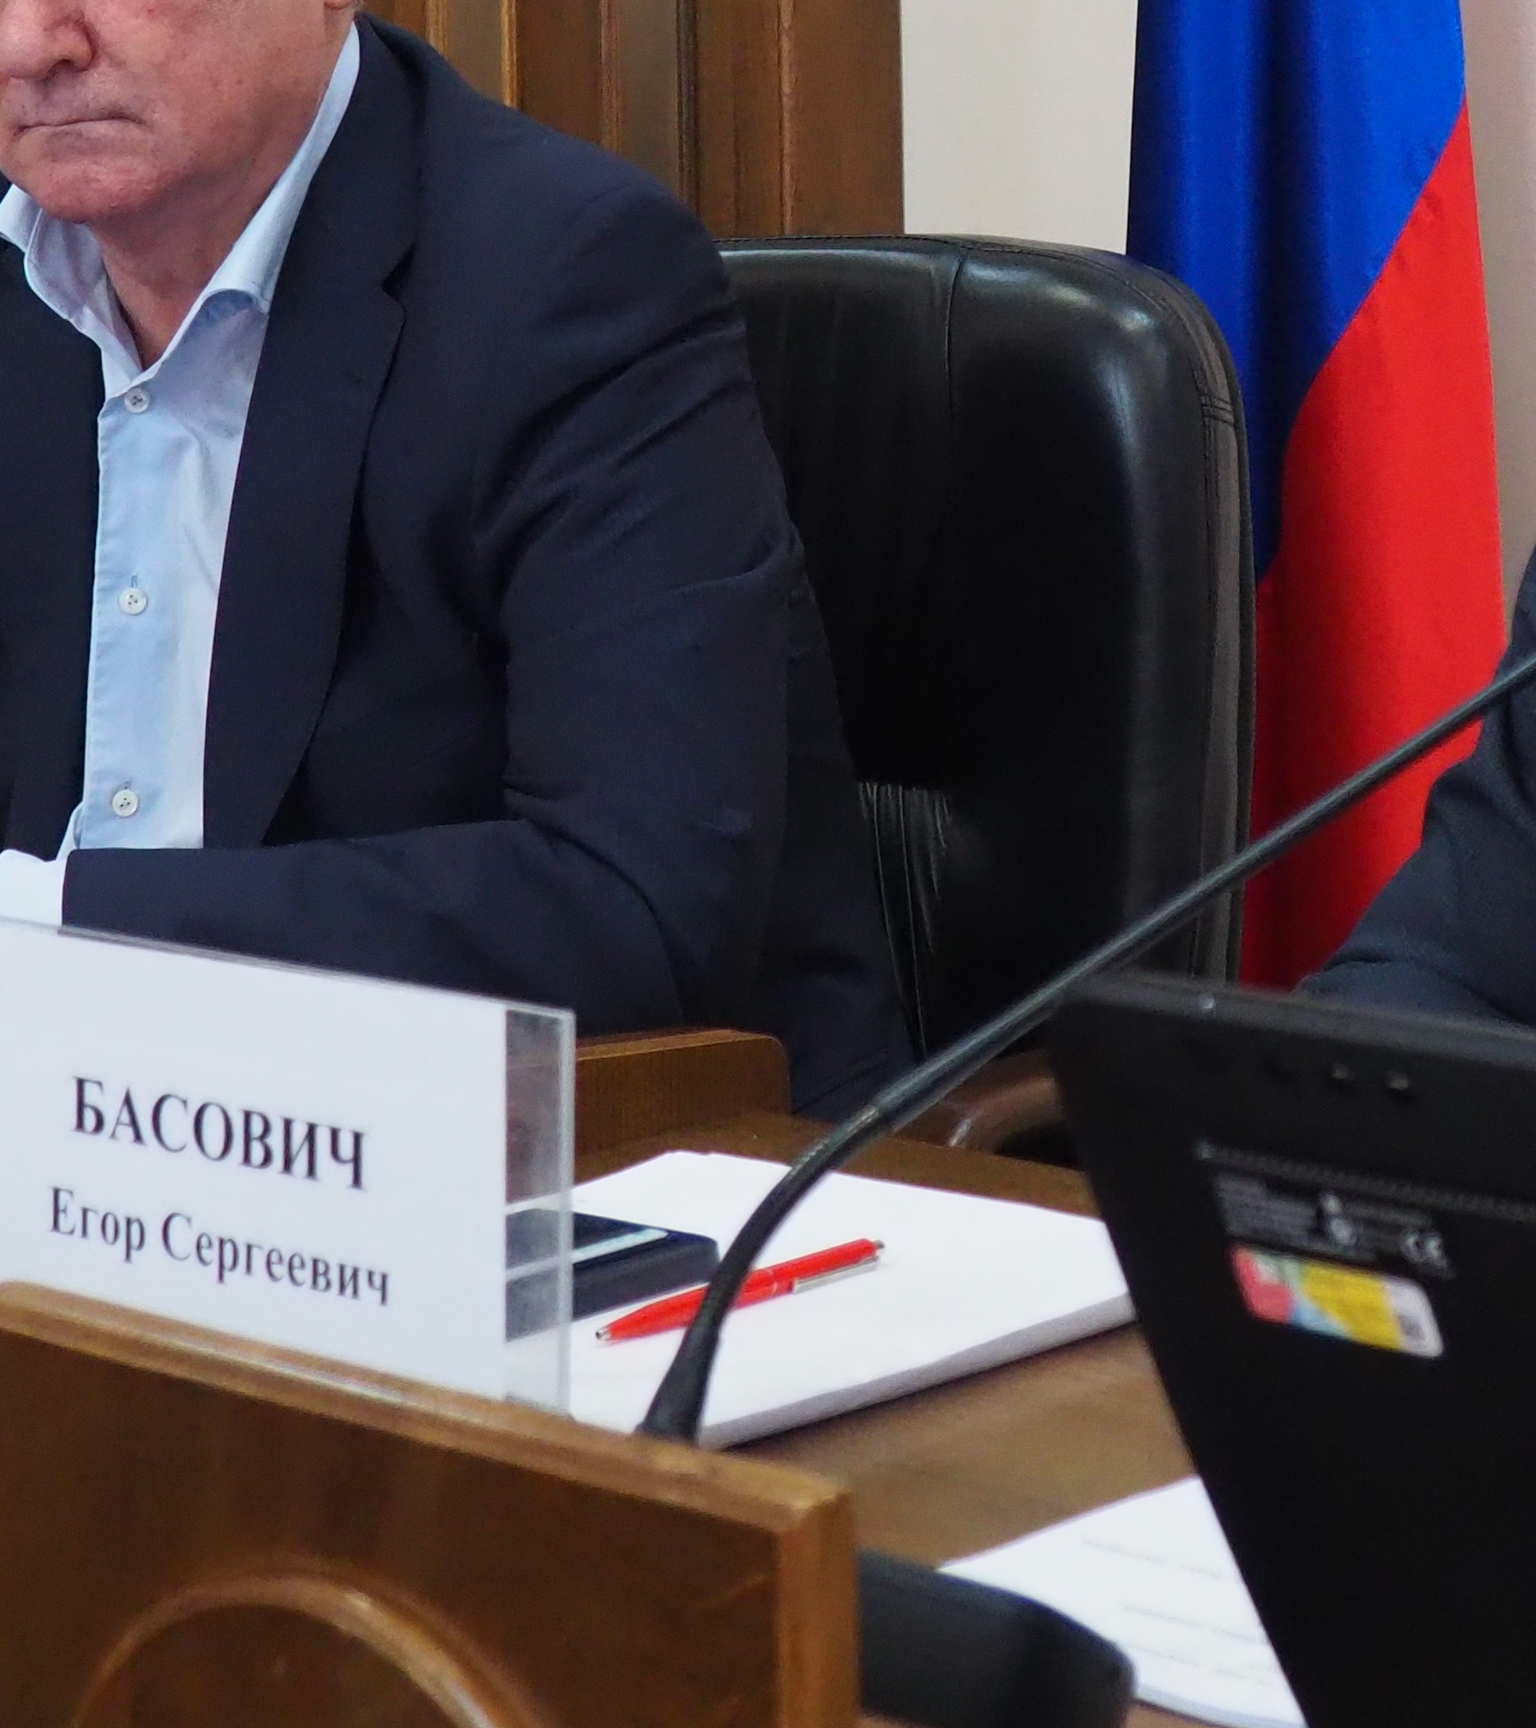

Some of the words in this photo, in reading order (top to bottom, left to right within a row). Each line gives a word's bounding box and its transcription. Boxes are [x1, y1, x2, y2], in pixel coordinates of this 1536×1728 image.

[72, 1076, 367, 1191] БАСОВИЧ
[50, 1186, 146, 1263] Егор
[161, 1212, 389, 1306] Сергеевич
